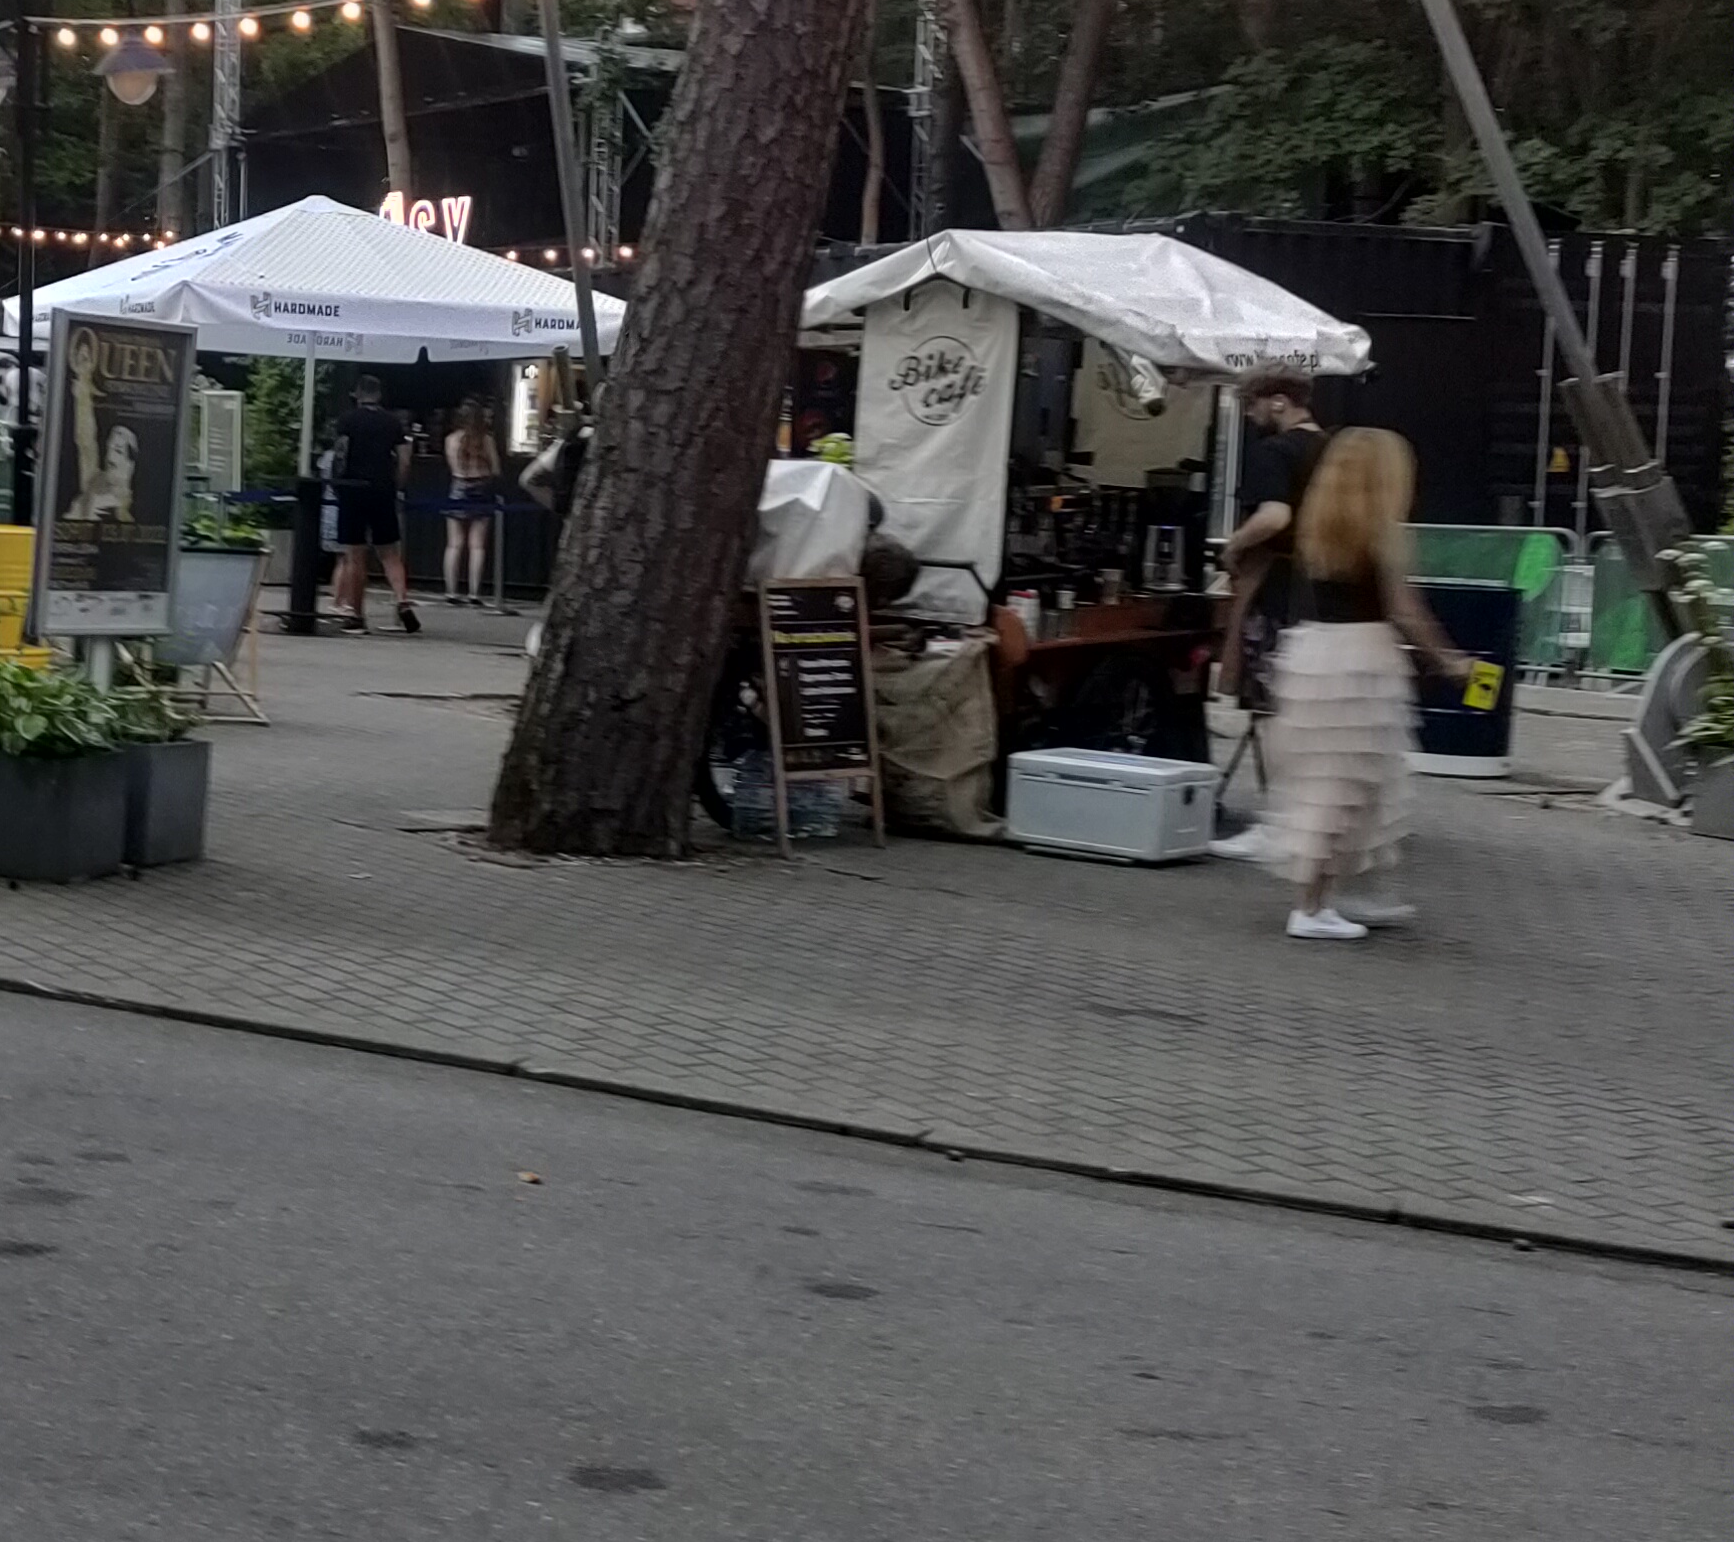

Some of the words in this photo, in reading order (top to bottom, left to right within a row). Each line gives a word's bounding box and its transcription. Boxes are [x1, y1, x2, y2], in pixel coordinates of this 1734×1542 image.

[274, 301, 340, 317] HARDMADE
[68, 326, 177, 383] QUEEN
[888, 350, 966, 391] Bike
